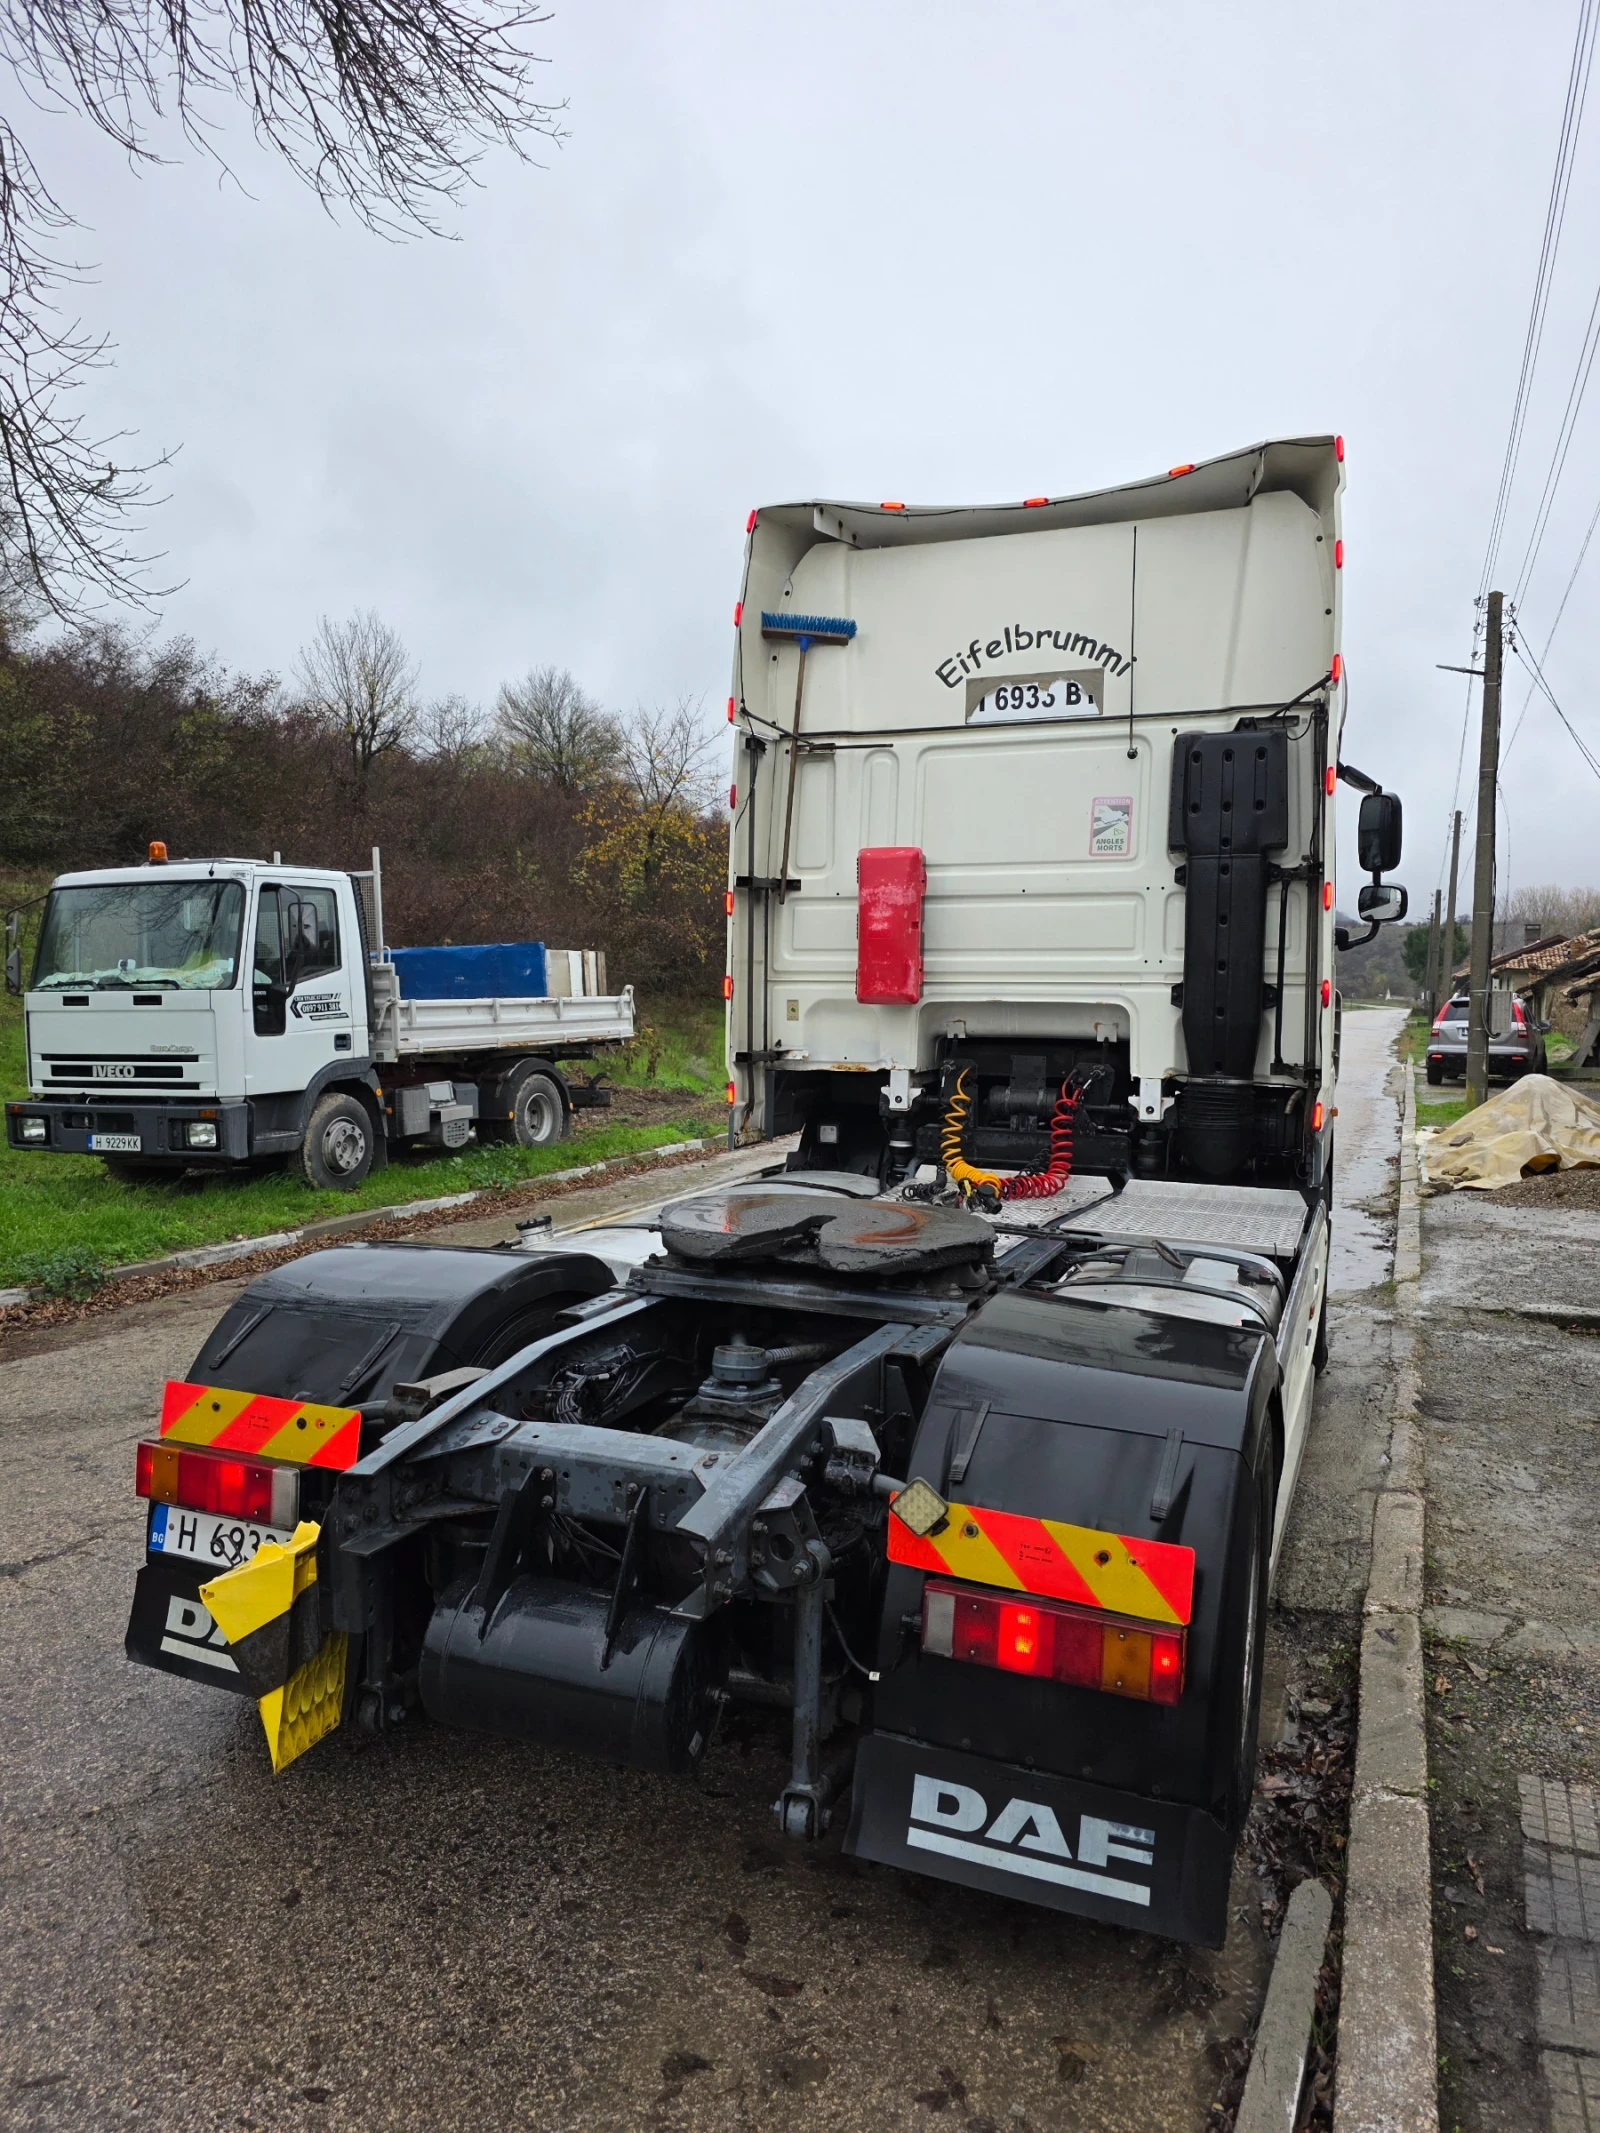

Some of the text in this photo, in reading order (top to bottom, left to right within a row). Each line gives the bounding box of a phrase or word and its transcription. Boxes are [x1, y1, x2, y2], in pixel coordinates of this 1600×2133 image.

[935, 624, 1138, 689] Eifelbrummi
[92, 1066, 135, 1078] IVECO
[105, 1138, 125, 1149] 9229
[152, 1532, 164, 1544] BG
[178, 1515, 197, 1552] H
[910, 1773, 1155, 1867] DAF
